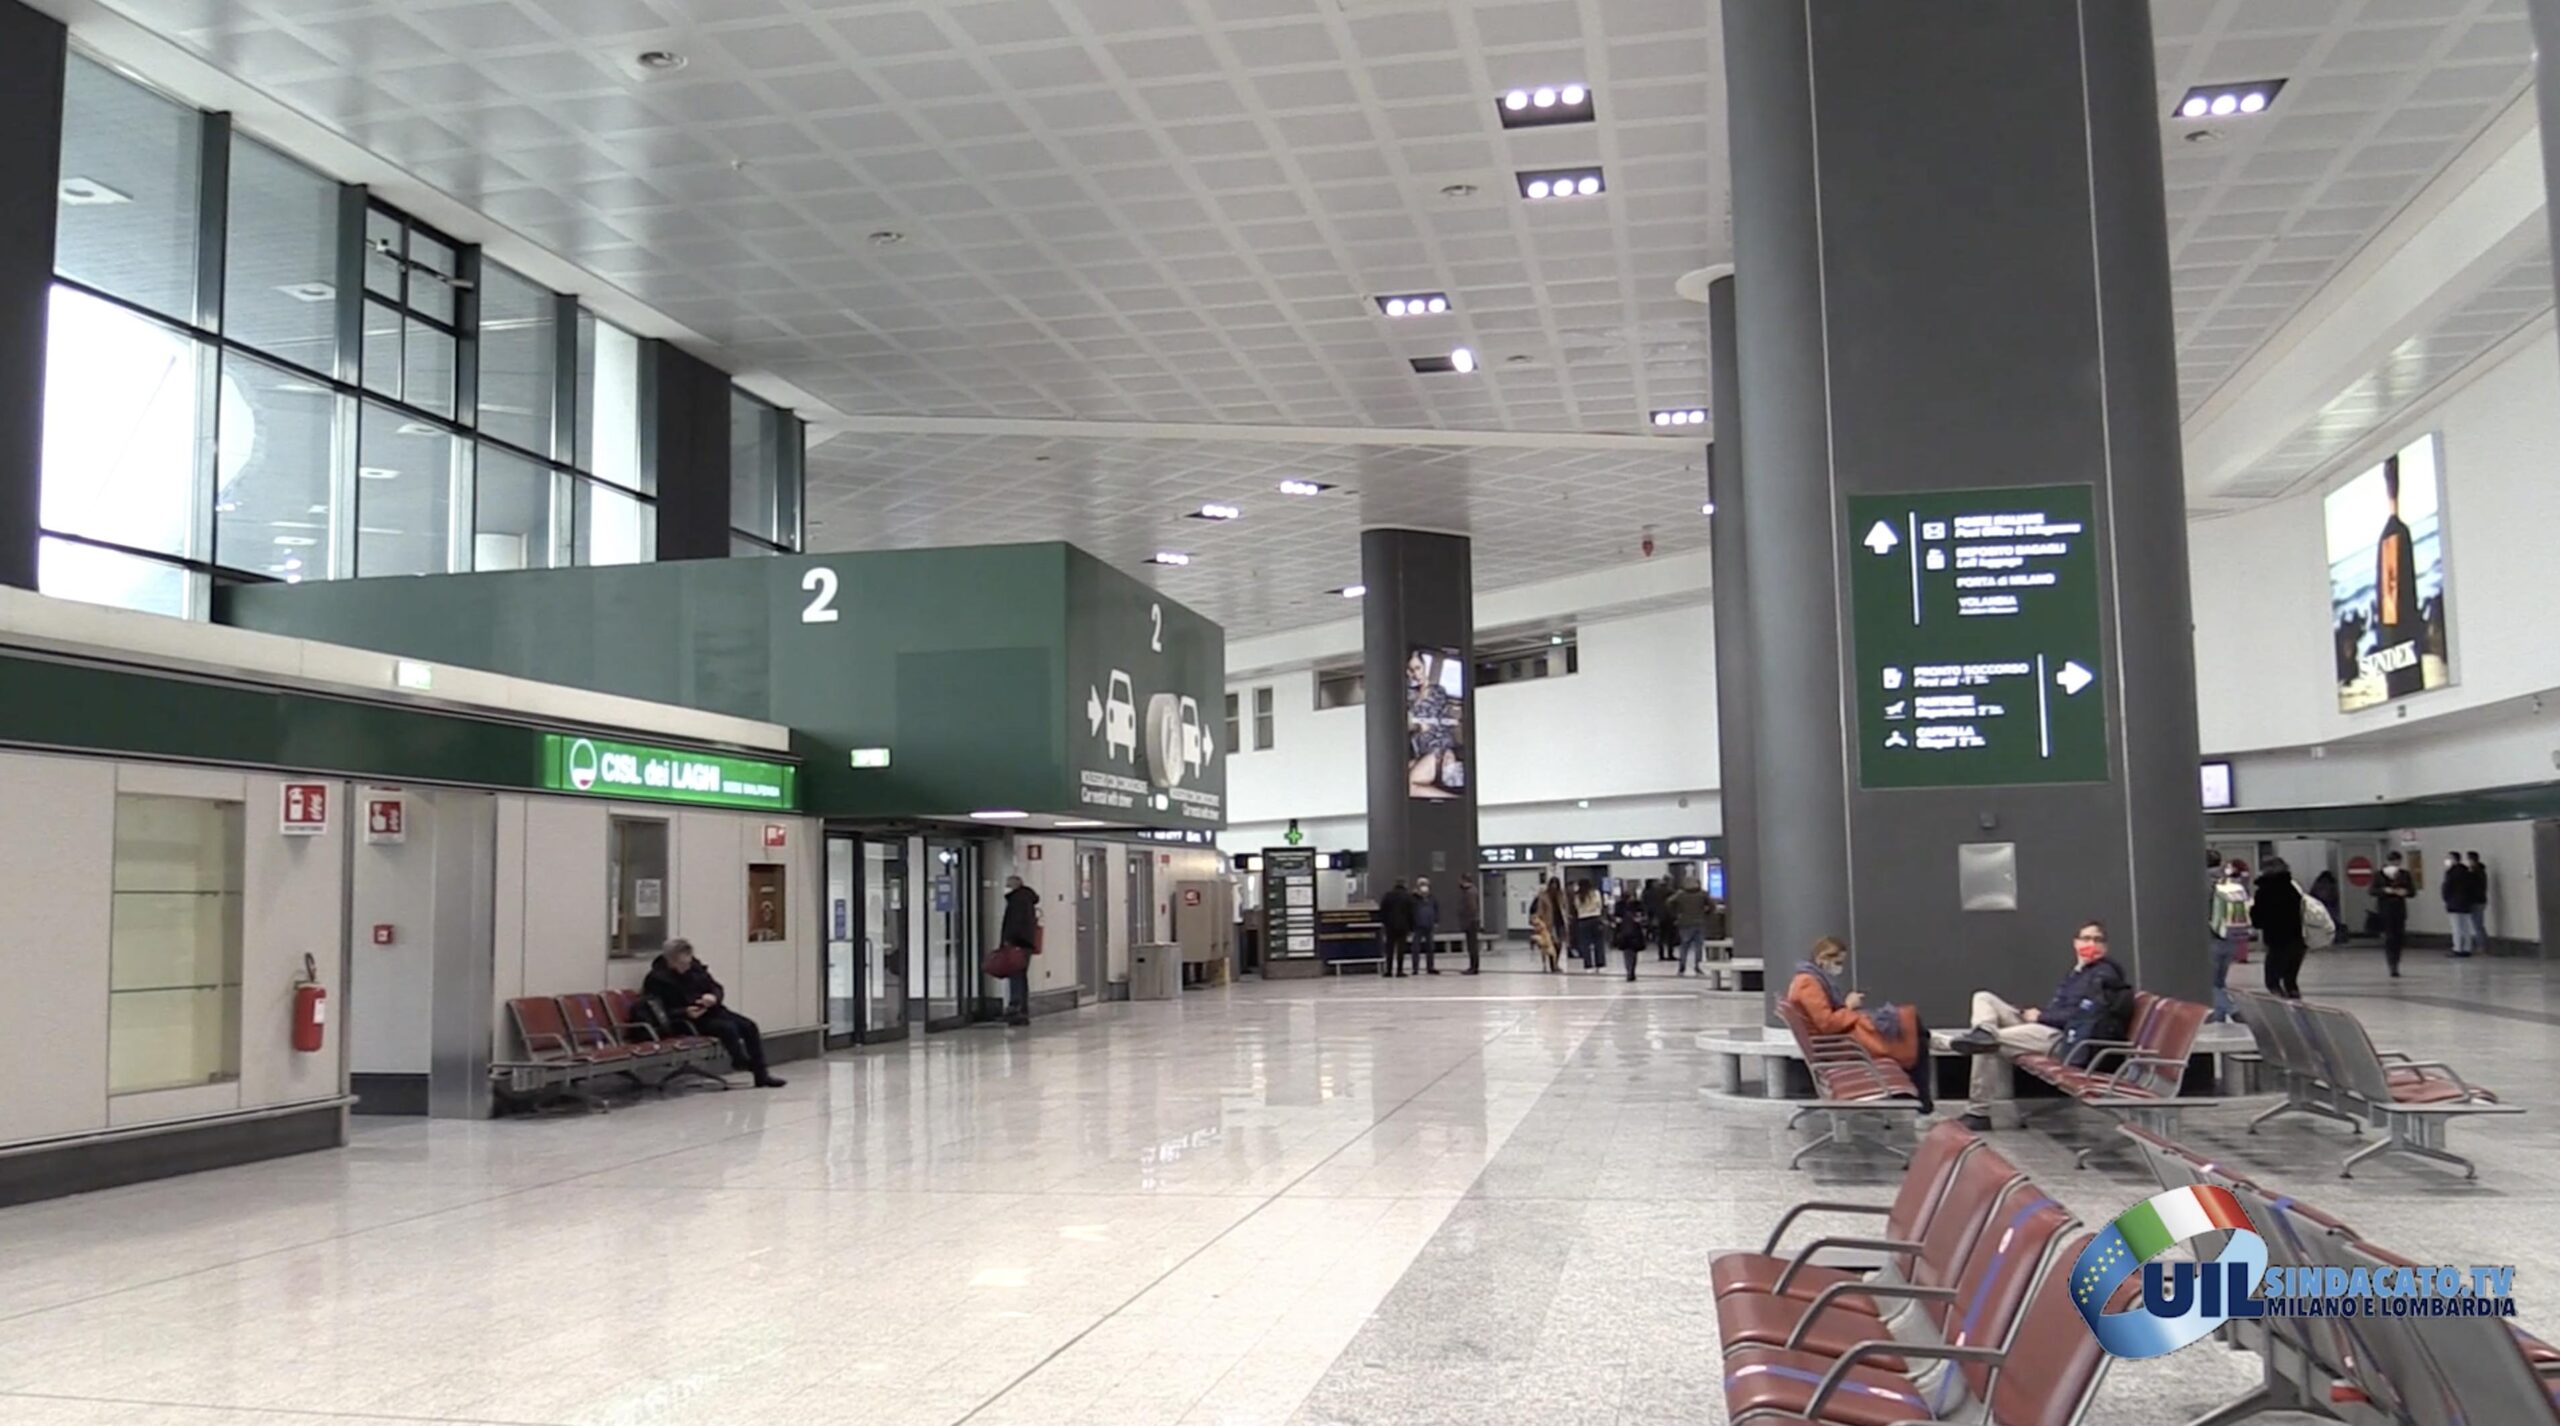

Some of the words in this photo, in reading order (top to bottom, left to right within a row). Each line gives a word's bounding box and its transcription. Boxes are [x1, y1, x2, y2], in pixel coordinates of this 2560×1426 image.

[802, 567, 838, 623] 2
[1956, 576, 1997, 588] PORTA
[2009, 573, 2055, 586] MILANO
[1151, 603, 1162, 653] 2
[1913, 665, 1962, 678] PRONTO
[1963, 663, 2030, 676] SOCCORSO
[601, 752, 642, 785] CISL
[644, 757, 671, 787] dei
[671, 760, 721, 792] LAGHI
